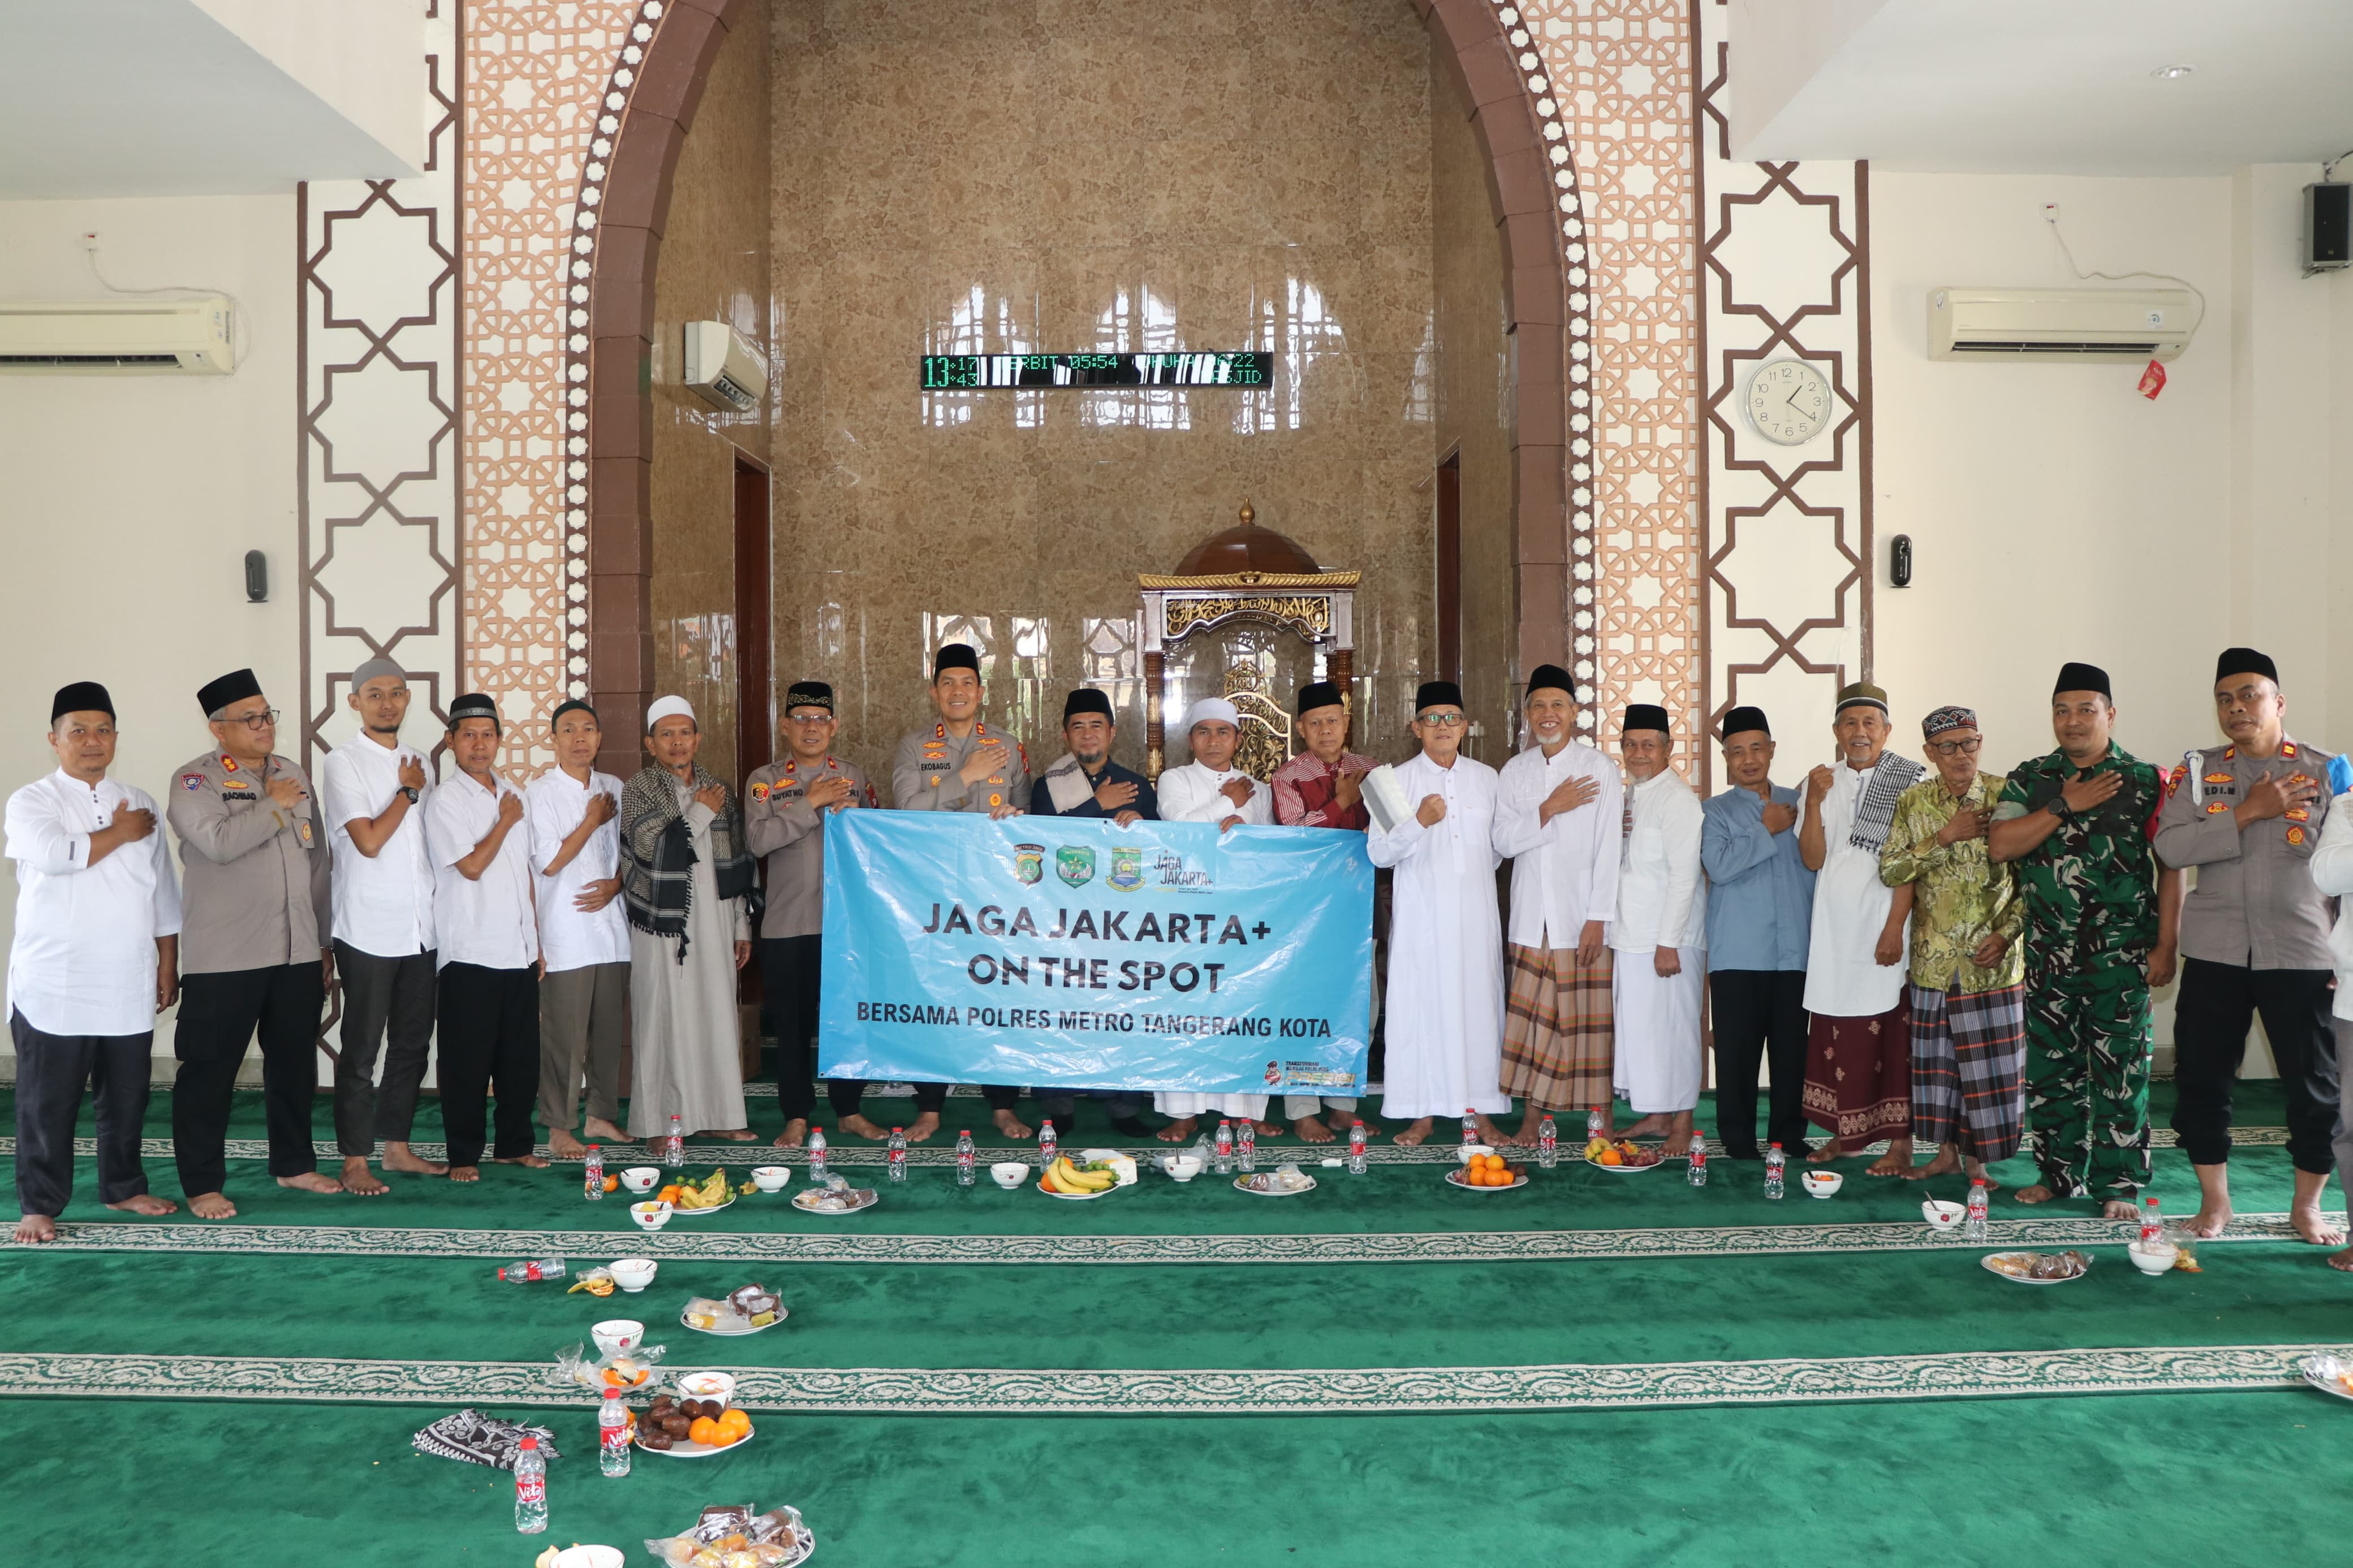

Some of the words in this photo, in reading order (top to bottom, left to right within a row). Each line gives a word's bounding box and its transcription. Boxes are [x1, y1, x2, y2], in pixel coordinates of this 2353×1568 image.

[1070, 355, 1118, 369] 05:54
[1769, 372, 1777, 381] 11
[1782, 368, 1792, 377] 12
[1800, 371, 1803, 380] 1
[1758, 383, 1769, 393] 10
[1808, 382, 1816, 391] 2
[1755, 398, 1764, 407] 9
[1813, 397, 1821, 406] 3
[1760, 412, 1768, 422] 8
[1810, 412, 1817, 421] 4
[1772, 424, 1779, 433] 7
[1785, 427, 1794, 437] 6
[1799, 423, 1807, 432] 5
[921, 762, 951, 771] EKOBAGUS
[1154, 853, 1182, 871] JAGA
[923, 903, 1038, 937] JAGA
[1049, 908, 1271, 945] JAKARTA+
[968, 954, 1029, 986] ON
[1038, 957, 1108, 989] THE
[1117, 960, 1225, 994] SPOT
[857, 1001, 960, 1025] BERSAMA
[967, 1007, 1051, 1029] POLRES
[1059, 1010, 1134, 1032] METRO
[1141, 1013, 1272, 1037] TANGERANG
[1279, 1018, 1331, 1038] KOTA
